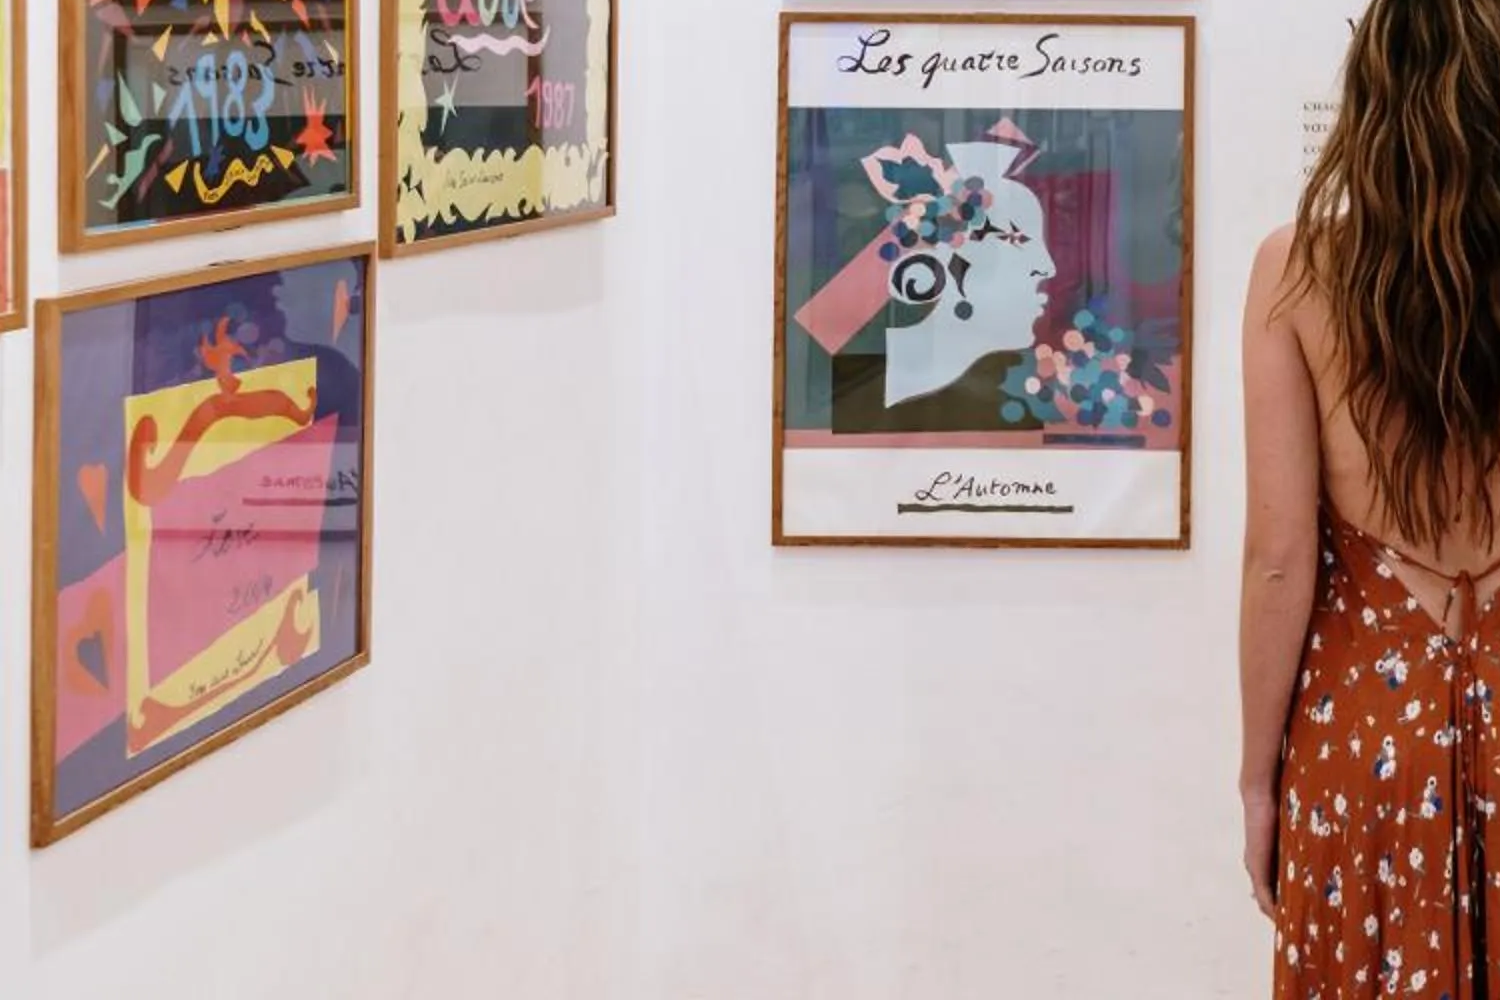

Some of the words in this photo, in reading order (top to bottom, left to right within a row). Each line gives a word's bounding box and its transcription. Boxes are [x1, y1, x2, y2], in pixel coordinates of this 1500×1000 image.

[836, 29, 908, 75] Les
[921, 49, 1020, 89] quatre
[1021, 33, 1142, 79] Saisons
[168, 50, 274, 157] 1983
